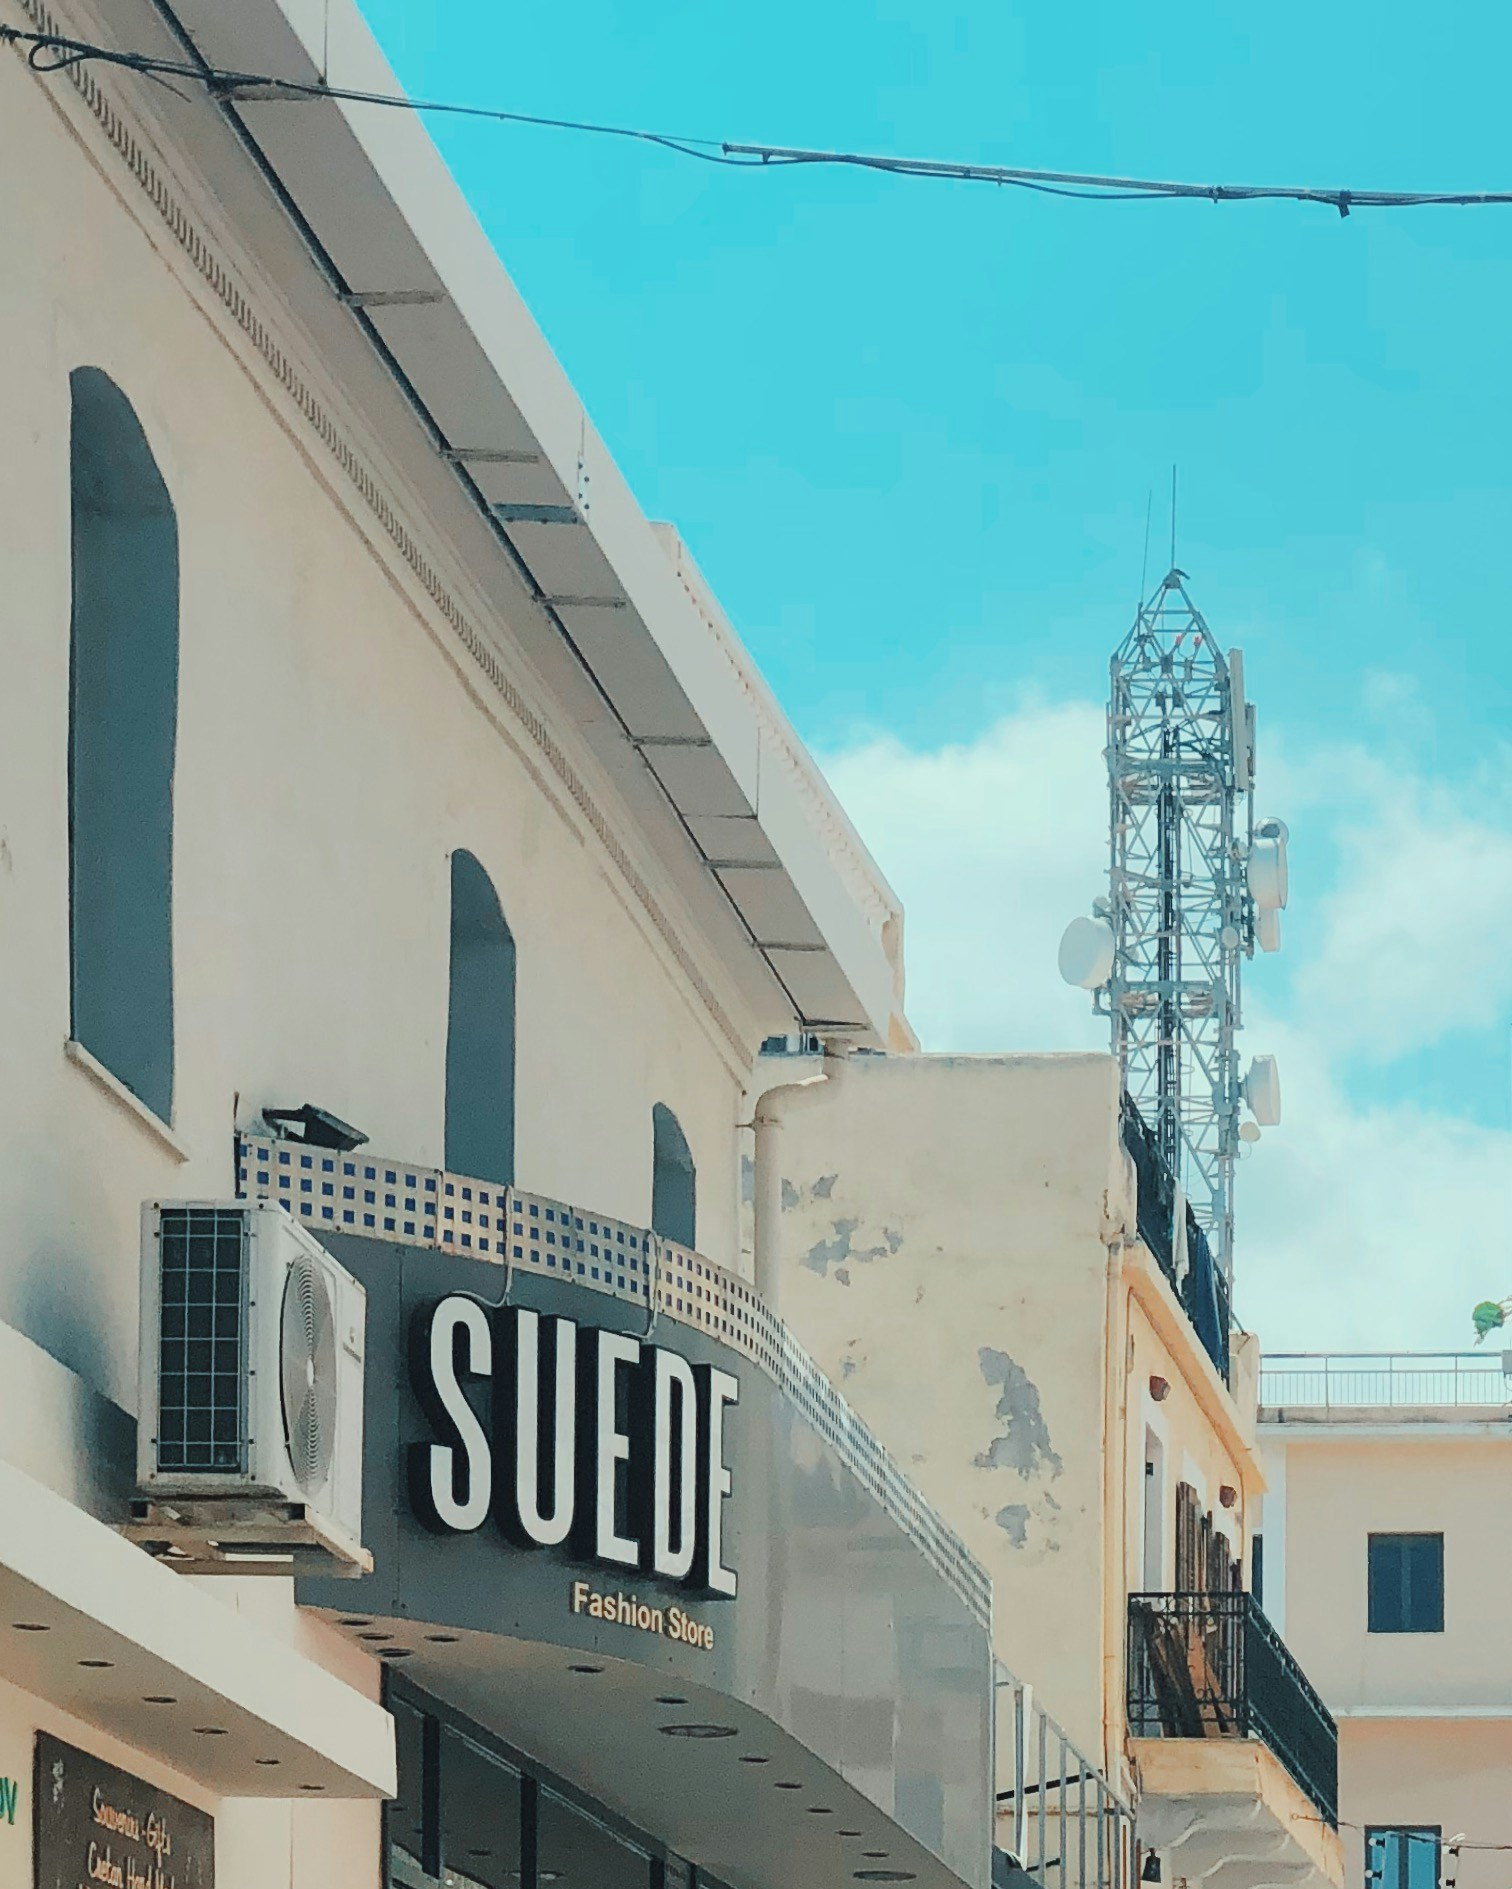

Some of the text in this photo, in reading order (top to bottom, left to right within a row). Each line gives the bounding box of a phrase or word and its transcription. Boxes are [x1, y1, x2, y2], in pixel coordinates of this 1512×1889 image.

[430, 1295, 739, 1597] SUEDE
[573, 1581, 715, 1651] Fashion Store
[93, 1786, 140, 1842] Souvenirs
[88, 1841, 124, 1889] Cretan
